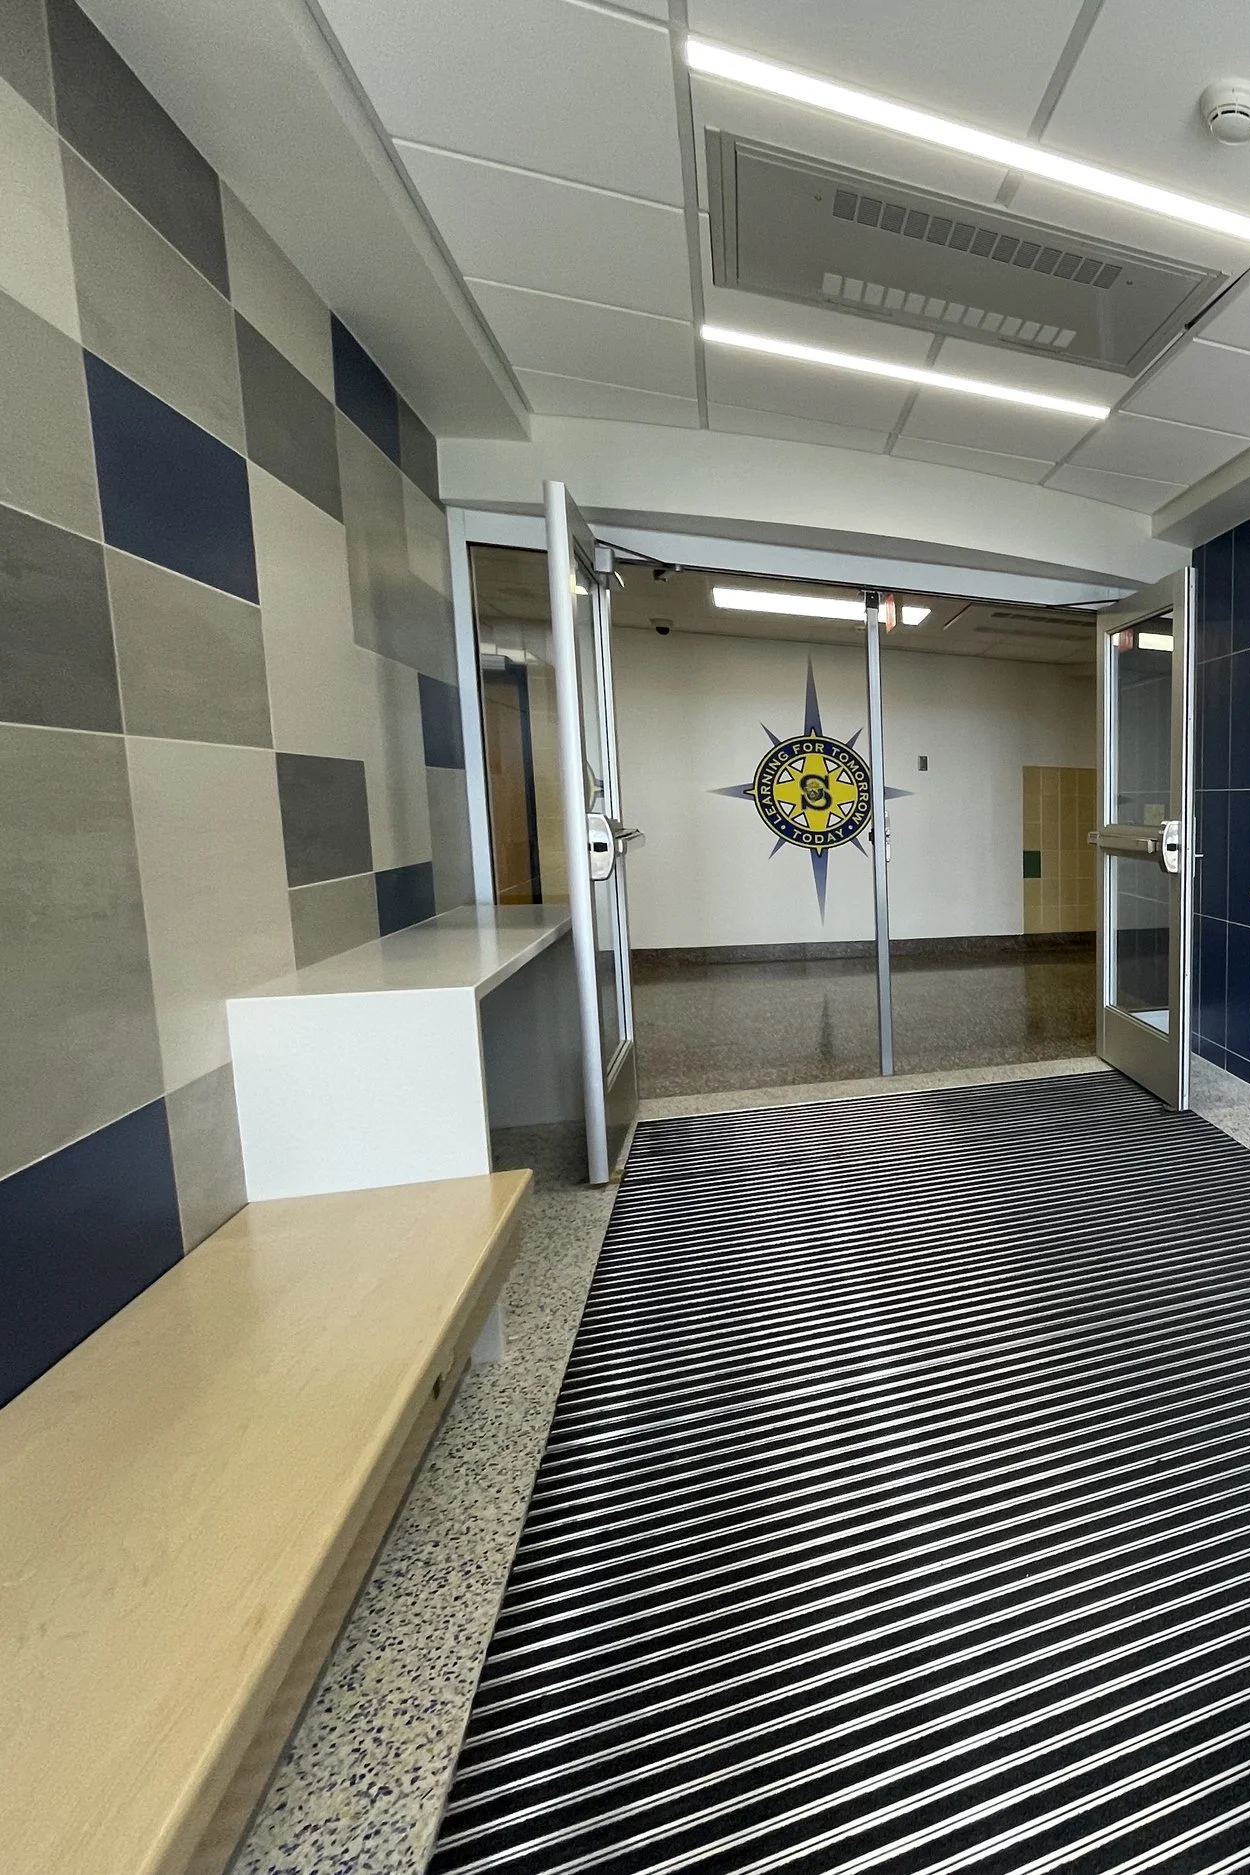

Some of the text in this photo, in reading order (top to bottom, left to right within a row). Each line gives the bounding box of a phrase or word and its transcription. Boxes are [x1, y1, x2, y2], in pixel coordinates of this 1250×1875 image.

[760, 742, 868, 824] LEARNING FOR TOMORROW
[792, 830, 844, 844] TODAY
